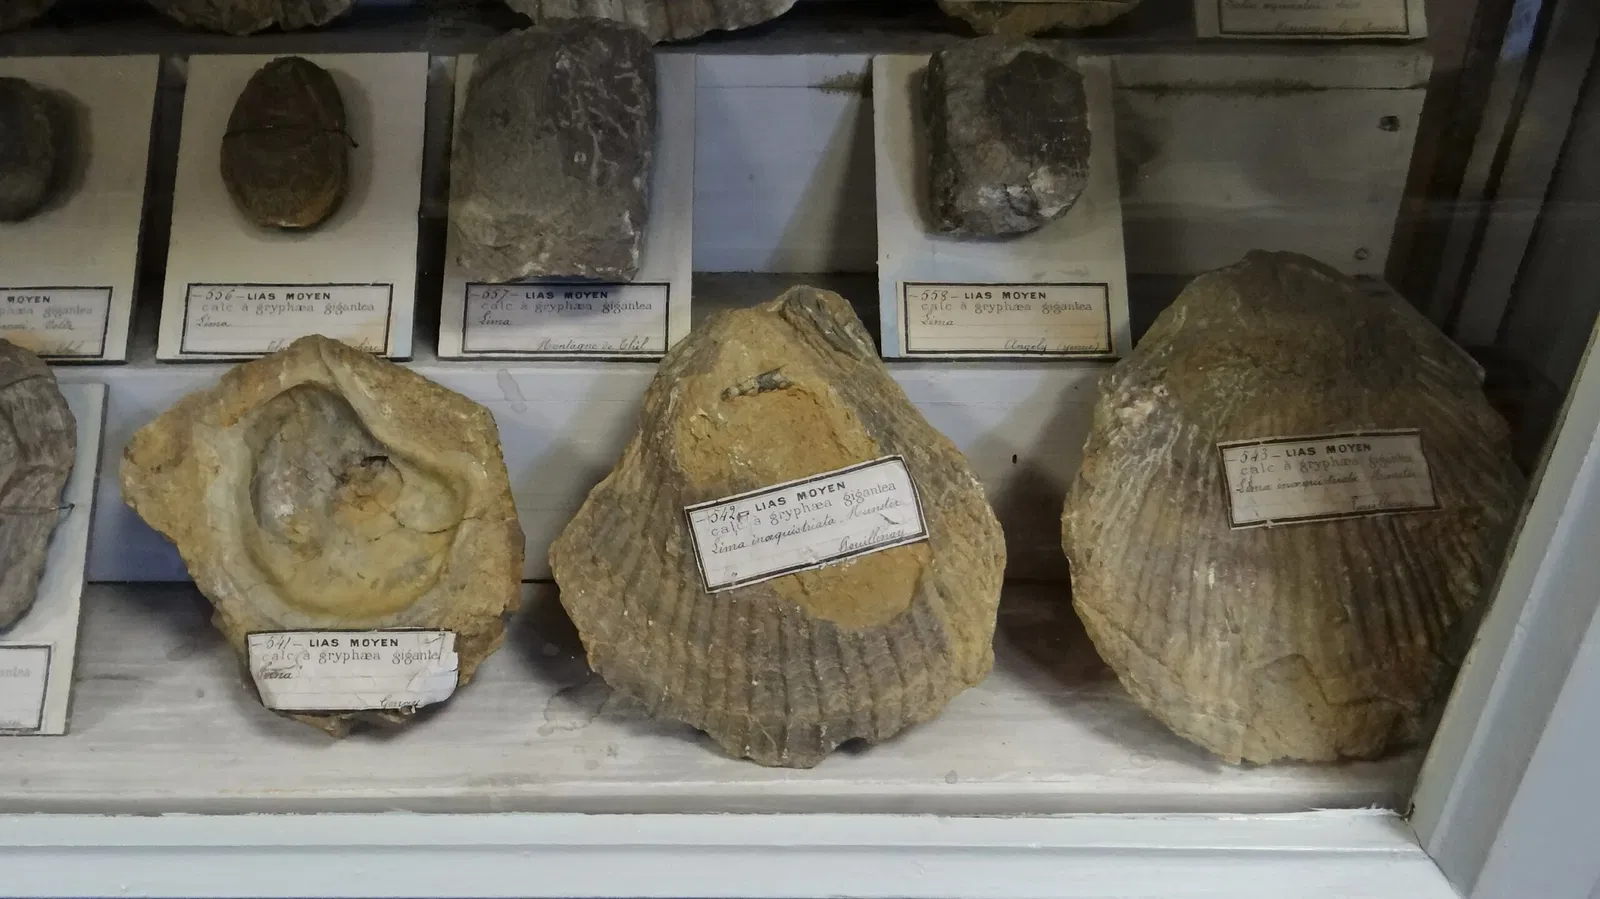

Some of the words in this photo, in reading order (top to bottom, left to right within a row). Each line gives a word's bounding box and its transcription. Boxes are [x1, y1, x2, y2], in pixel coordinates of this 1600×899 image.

[7, 295, 51, 304] MOYEN
[247, 292, 276, 300] LIAS
[285, 292, 332, 300] MOYEN
[525, 291, 554, 299] LIAS
[564, 291, 609, 299] MOYEN
[964, 291, 993, 300] LIAS
[1002, 291, 1047, 300] MOYEN
[201, 302, 233, 312] calc
[255, 302, 315, 315] gryphæa
[323, 302, 375, 315] gigantea
[480, 301, 513, 310] calc
[534, 301, 592, 314] gryphæa
[602, 301, 652, 314] gigantea
[921, 301, 952, 311] calc
[974, 301, 1032, 314] gryphæa
[1041, 301, 1093, 314] gigantea
[478, 311, 512, 326] Lima
[920, 314, 955, 327] Lima
[1285, 447, 1316, 458] LIAS
[1326, 443, 1372, 455] MOYEN
[1240, 463, 1275, 476] calc
[755, 496, 787, 512] LIAS
[796, 480, 846, 502] MOYEN
[769, 498, 833, 526] gryphæa
[843, 481, 897, 508] gigantea
[711, 537, 747, 555] Lima
[309, 638, 340, 648] LIAS
[350, 638, 400, 648] MOYEN
[261, 649, 293, 662] calc
[318, 649, 381, 665] gryphæa
[392, 648, 441, 665] gigante
